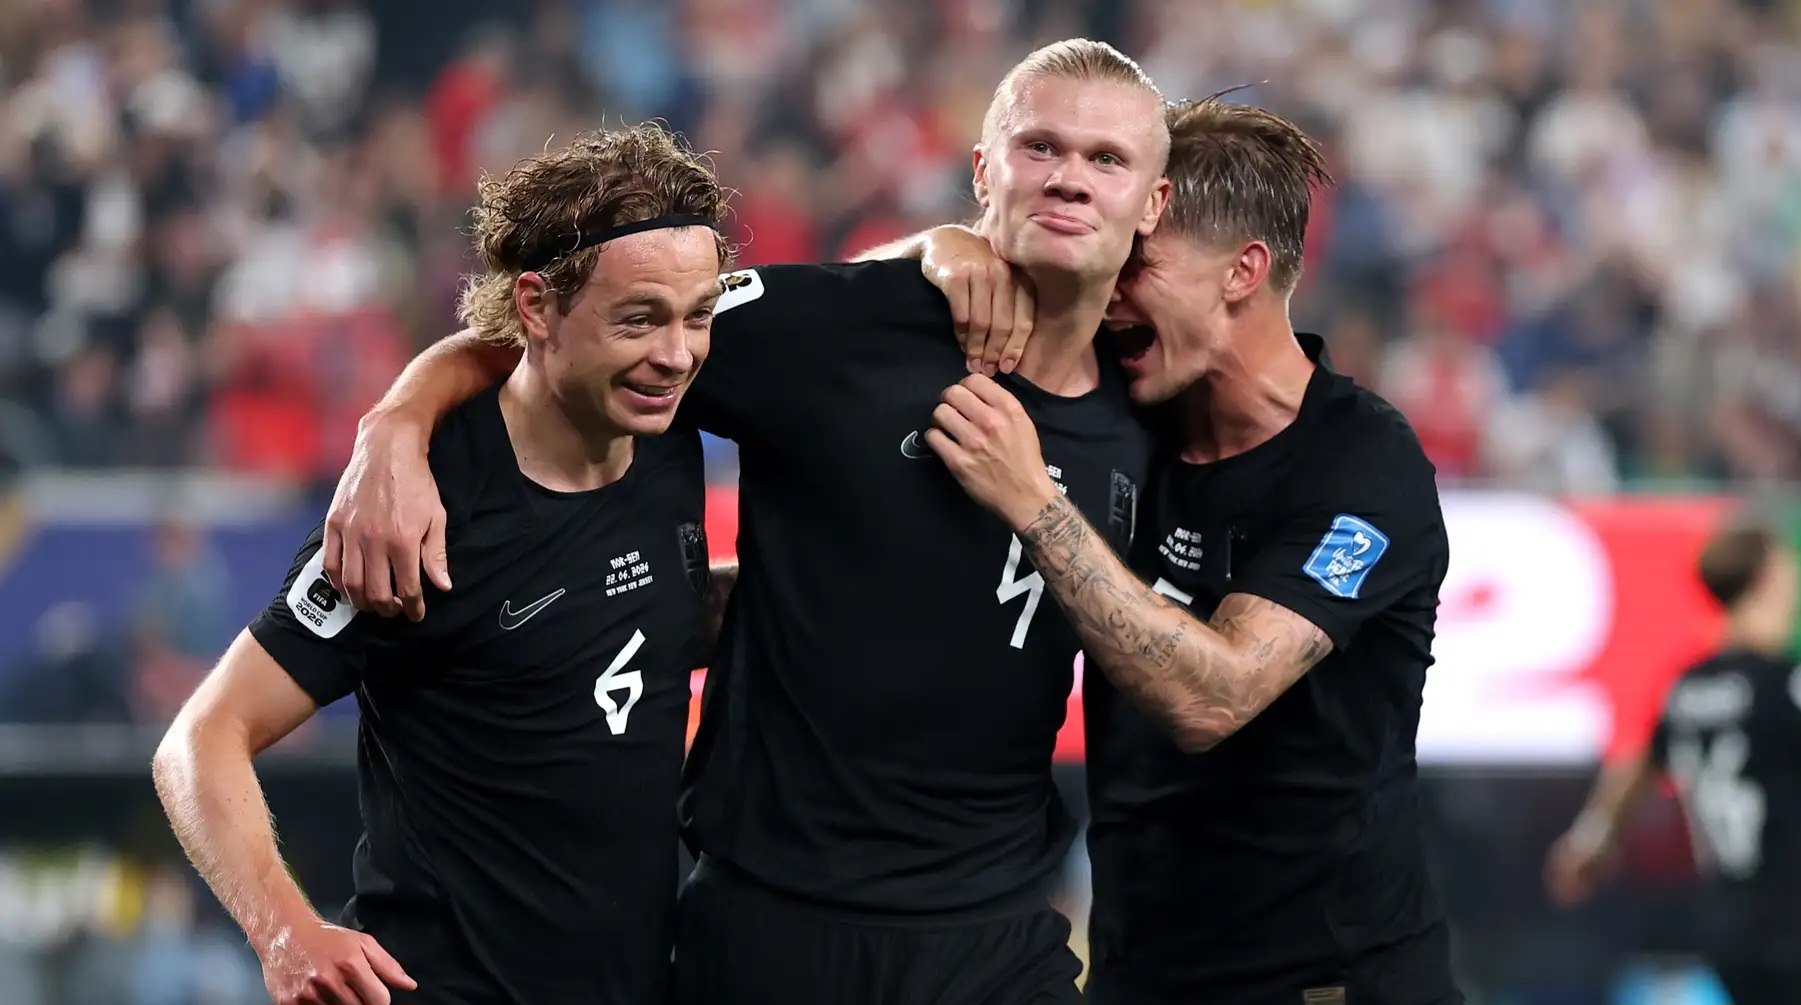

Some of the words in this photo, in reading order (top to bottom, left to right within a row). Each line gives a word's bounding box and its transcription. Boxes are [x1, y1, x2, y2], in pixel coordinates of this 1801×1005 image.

[300, 596, 318, 613] WORLD
[315, 609, 328, 621] CUP
[312, 592, 328, 607] FIFA
[295, 601, 324, 627] 2026
[1414, 490, 1615, 763] 2
[594, 628, 646, 736] 6
